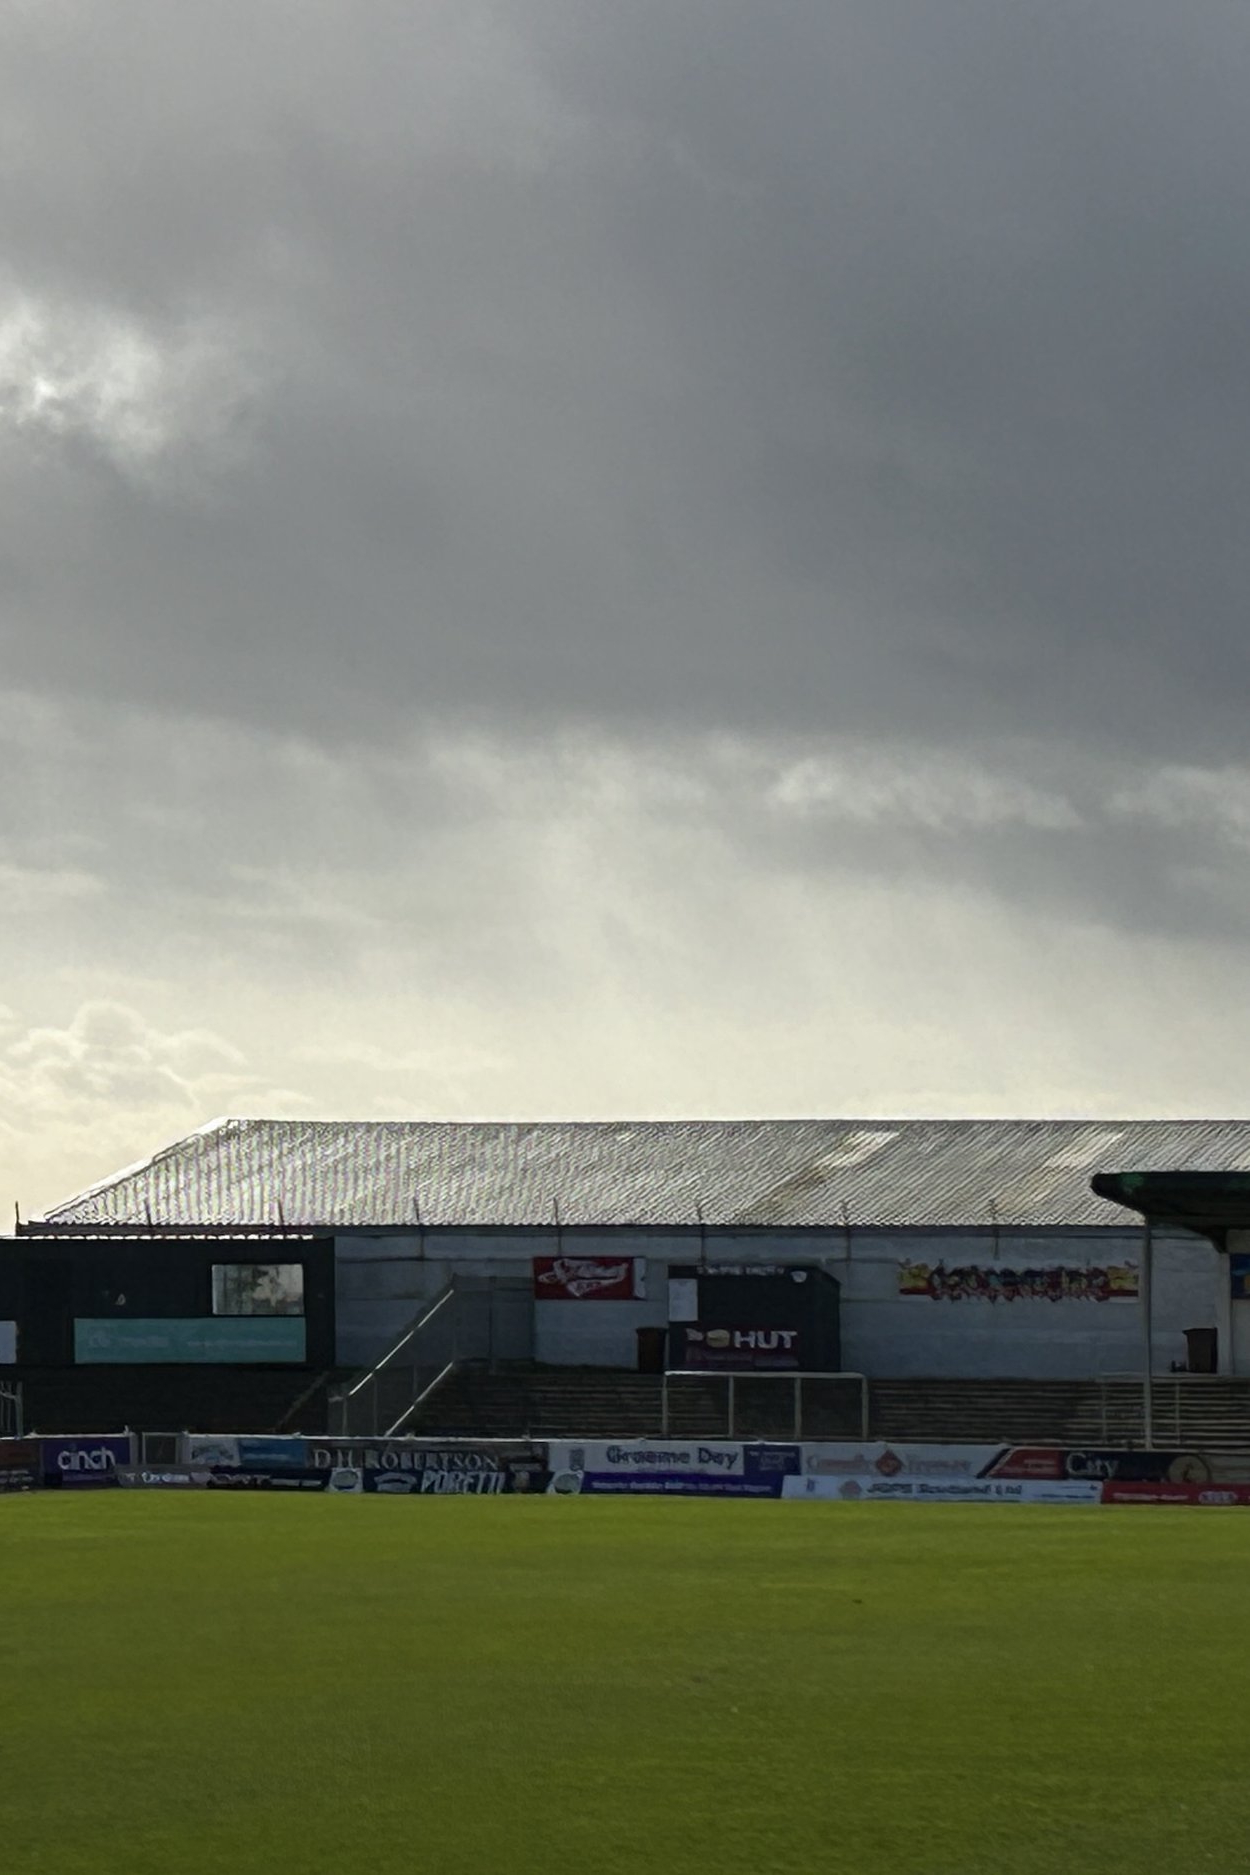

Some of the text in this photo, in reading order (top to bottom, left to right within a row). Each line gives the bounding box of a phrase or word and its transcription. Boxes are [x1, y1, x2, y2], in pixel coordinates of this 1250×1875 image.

[733, 1329, 798, 1349] HUT
[58, 1445, 116, 1471] cinch
[364, 1449, 500, 1471] ROBERTSON
[606, 1446, 691, 1465] Graeme
[698, 1447, 738, 1471] Day
